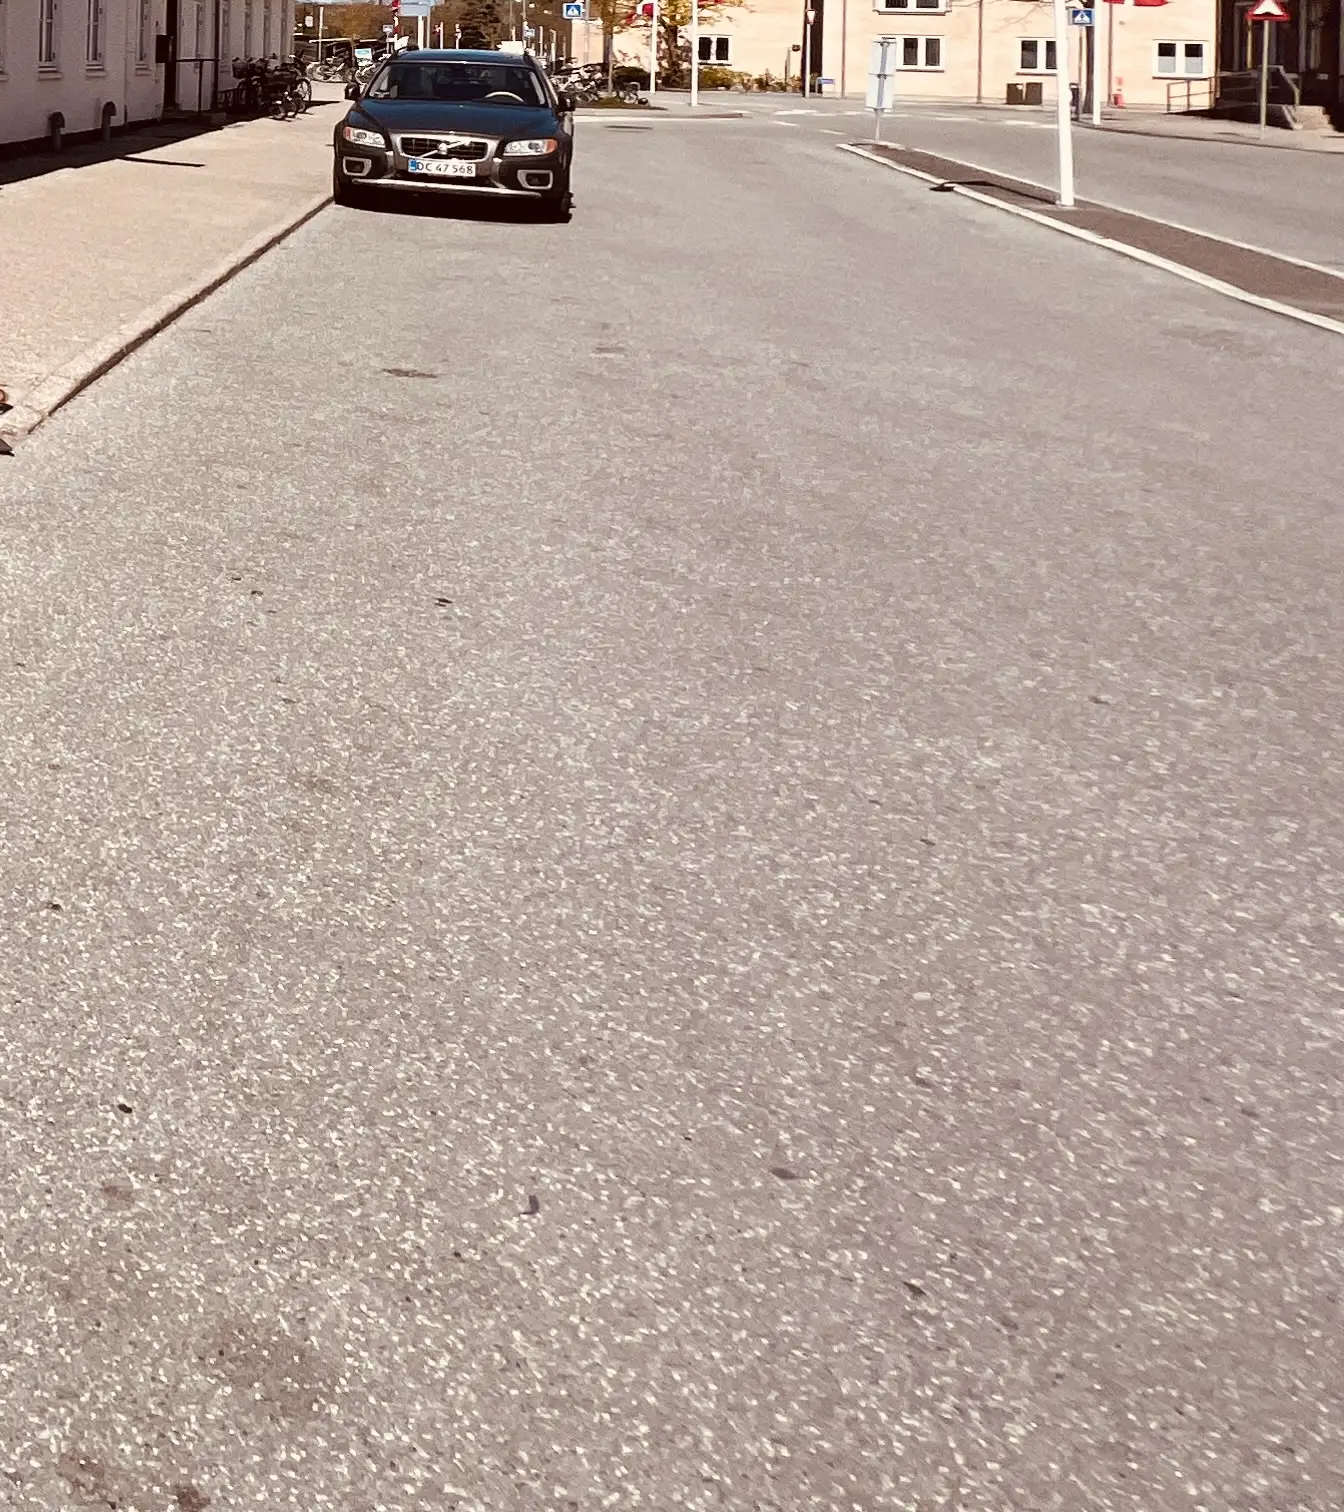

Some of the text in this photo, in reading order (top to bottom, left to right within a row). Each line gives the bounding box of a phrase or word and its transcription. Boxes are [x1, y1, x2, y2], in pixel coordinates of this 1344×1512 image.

[417, 161, 473, 175] DC 47 568
